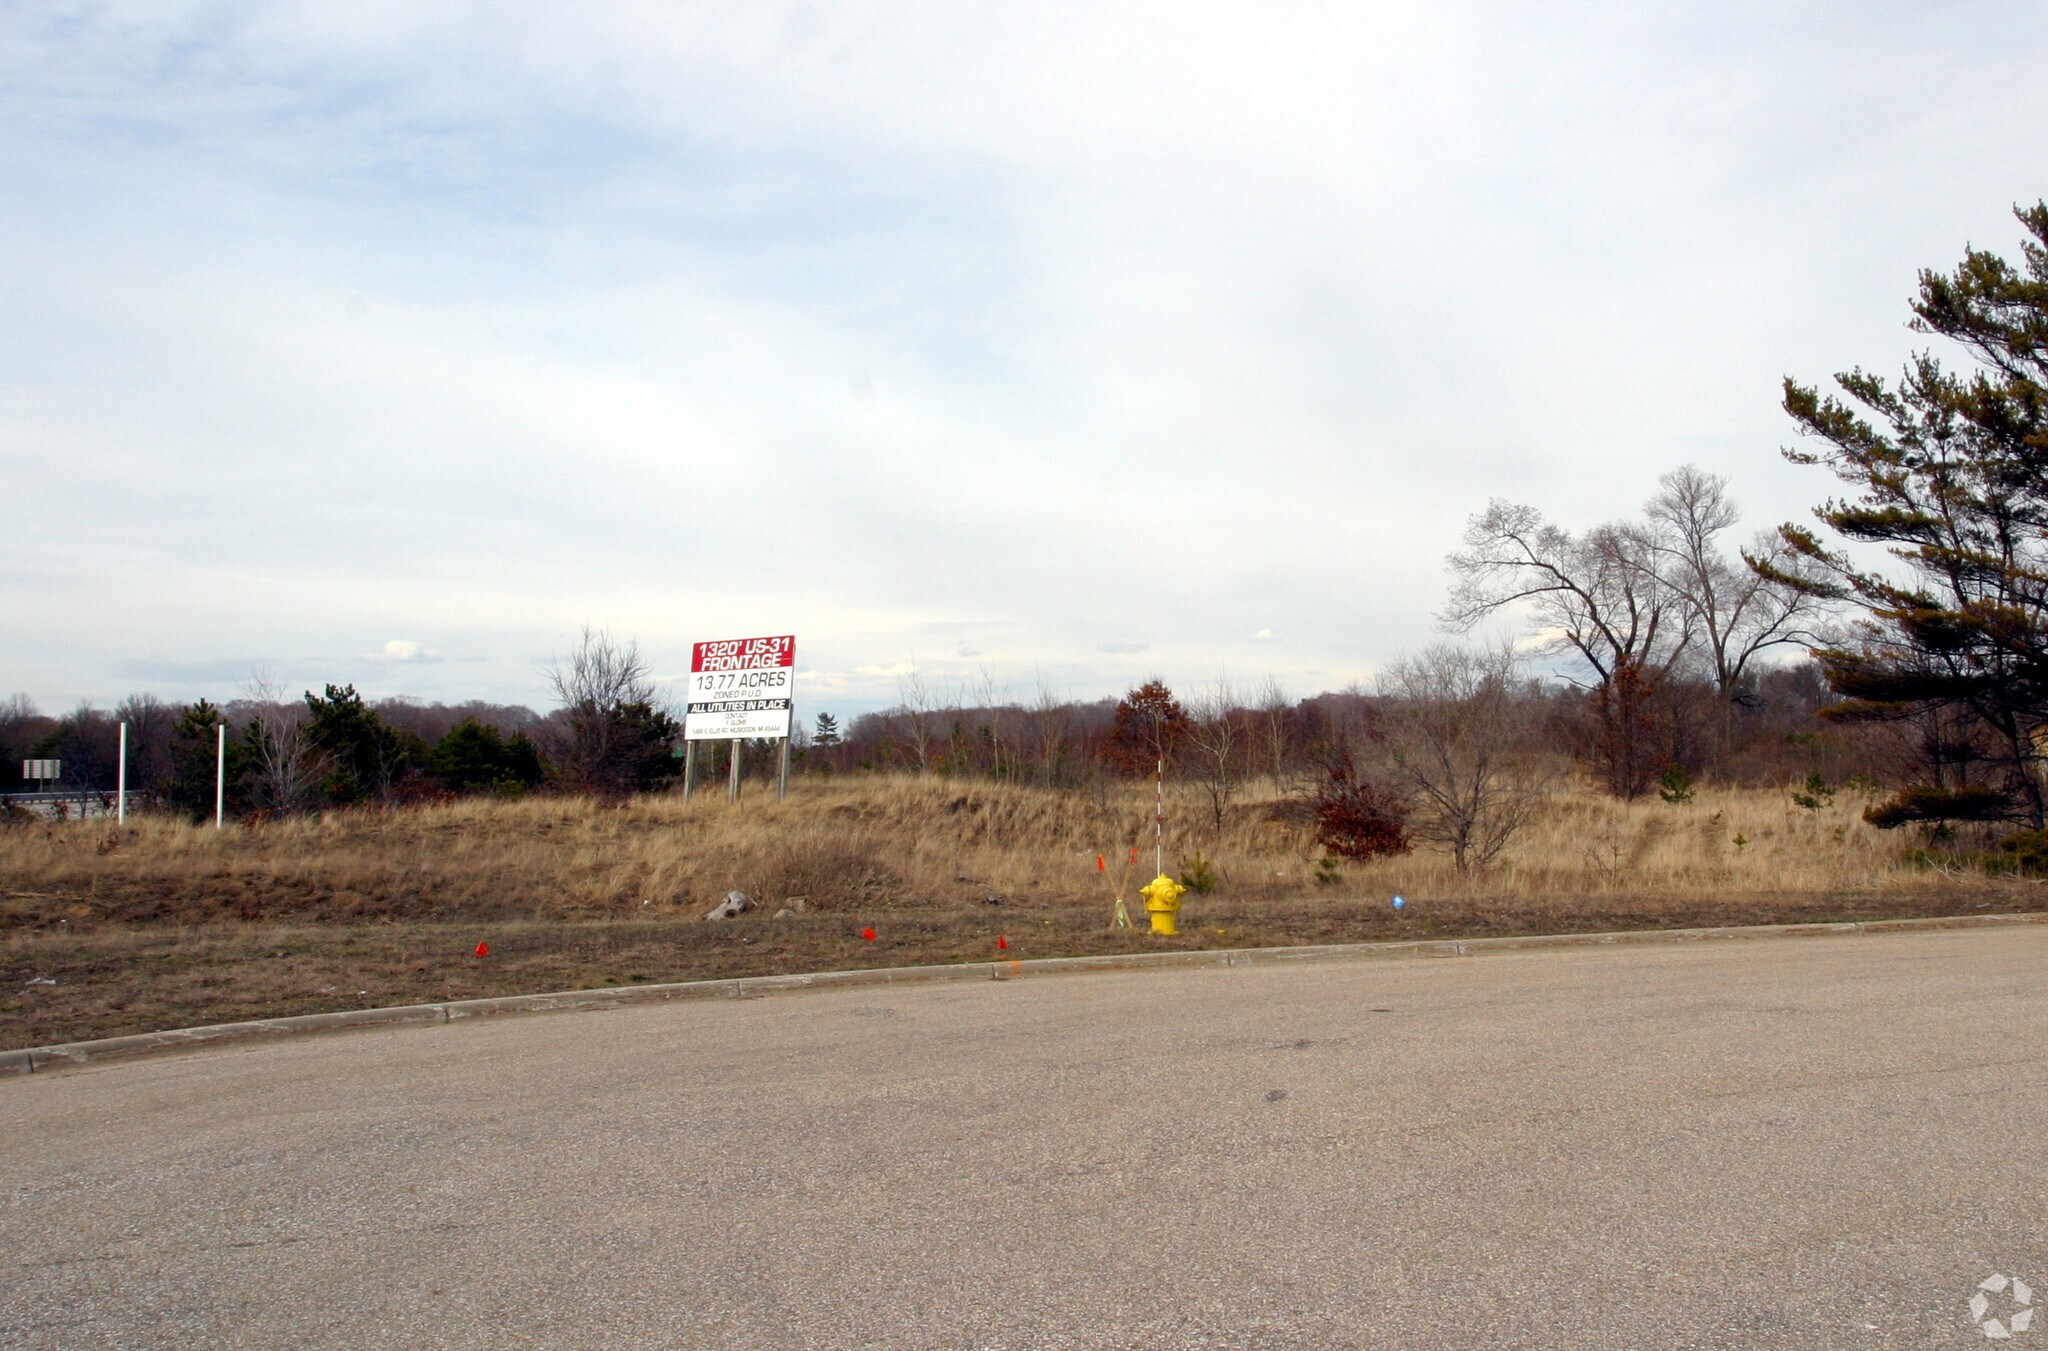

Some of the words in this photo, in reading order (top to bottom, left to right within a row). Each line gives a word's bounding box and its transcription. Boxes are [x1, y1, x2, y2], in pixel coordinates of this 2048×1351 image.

[700, 642, 742, 658] 1320'
[744, 637, 790, 655] US-31
[701, 653, 782, 671] FRONTAGE
[697, 674, 735, 690] 13.77
[738, 671, 786, 688] ACRES
[713, 690, 740, 699] ZONED
[690, 703, 706, 713] ALL
[707, 701, 745, 712] UTILITIES
[746, 700, 757, 710] IN
[757, 699, 786, 710] PLACE
